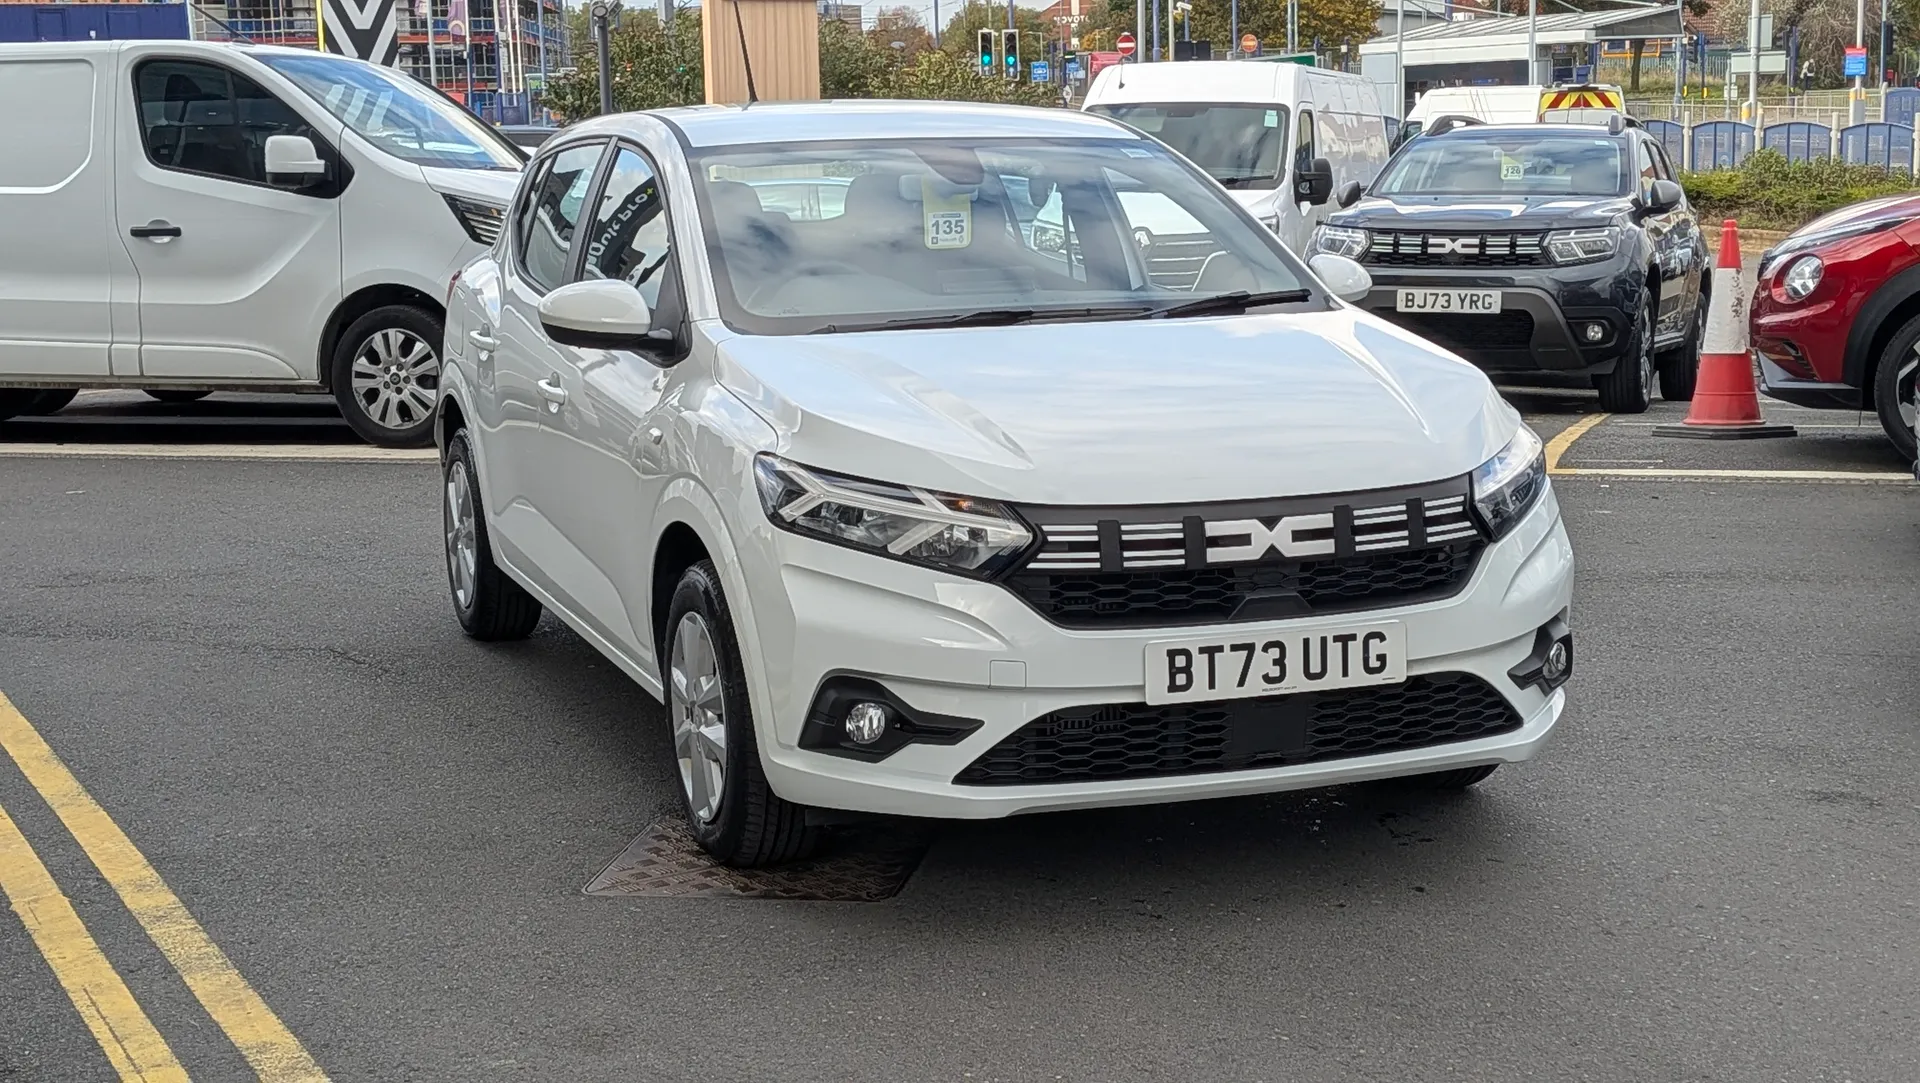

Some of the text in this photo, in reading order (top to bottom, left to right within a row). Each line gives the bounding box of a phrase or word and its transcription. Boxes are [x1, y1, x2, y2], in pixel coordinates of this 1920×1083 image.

[931, 219, 965, 235] 135
[1404, 292, 1493, 310] BJ73 YRG
[1166, 631, 1387, 693] BT73 UTG
